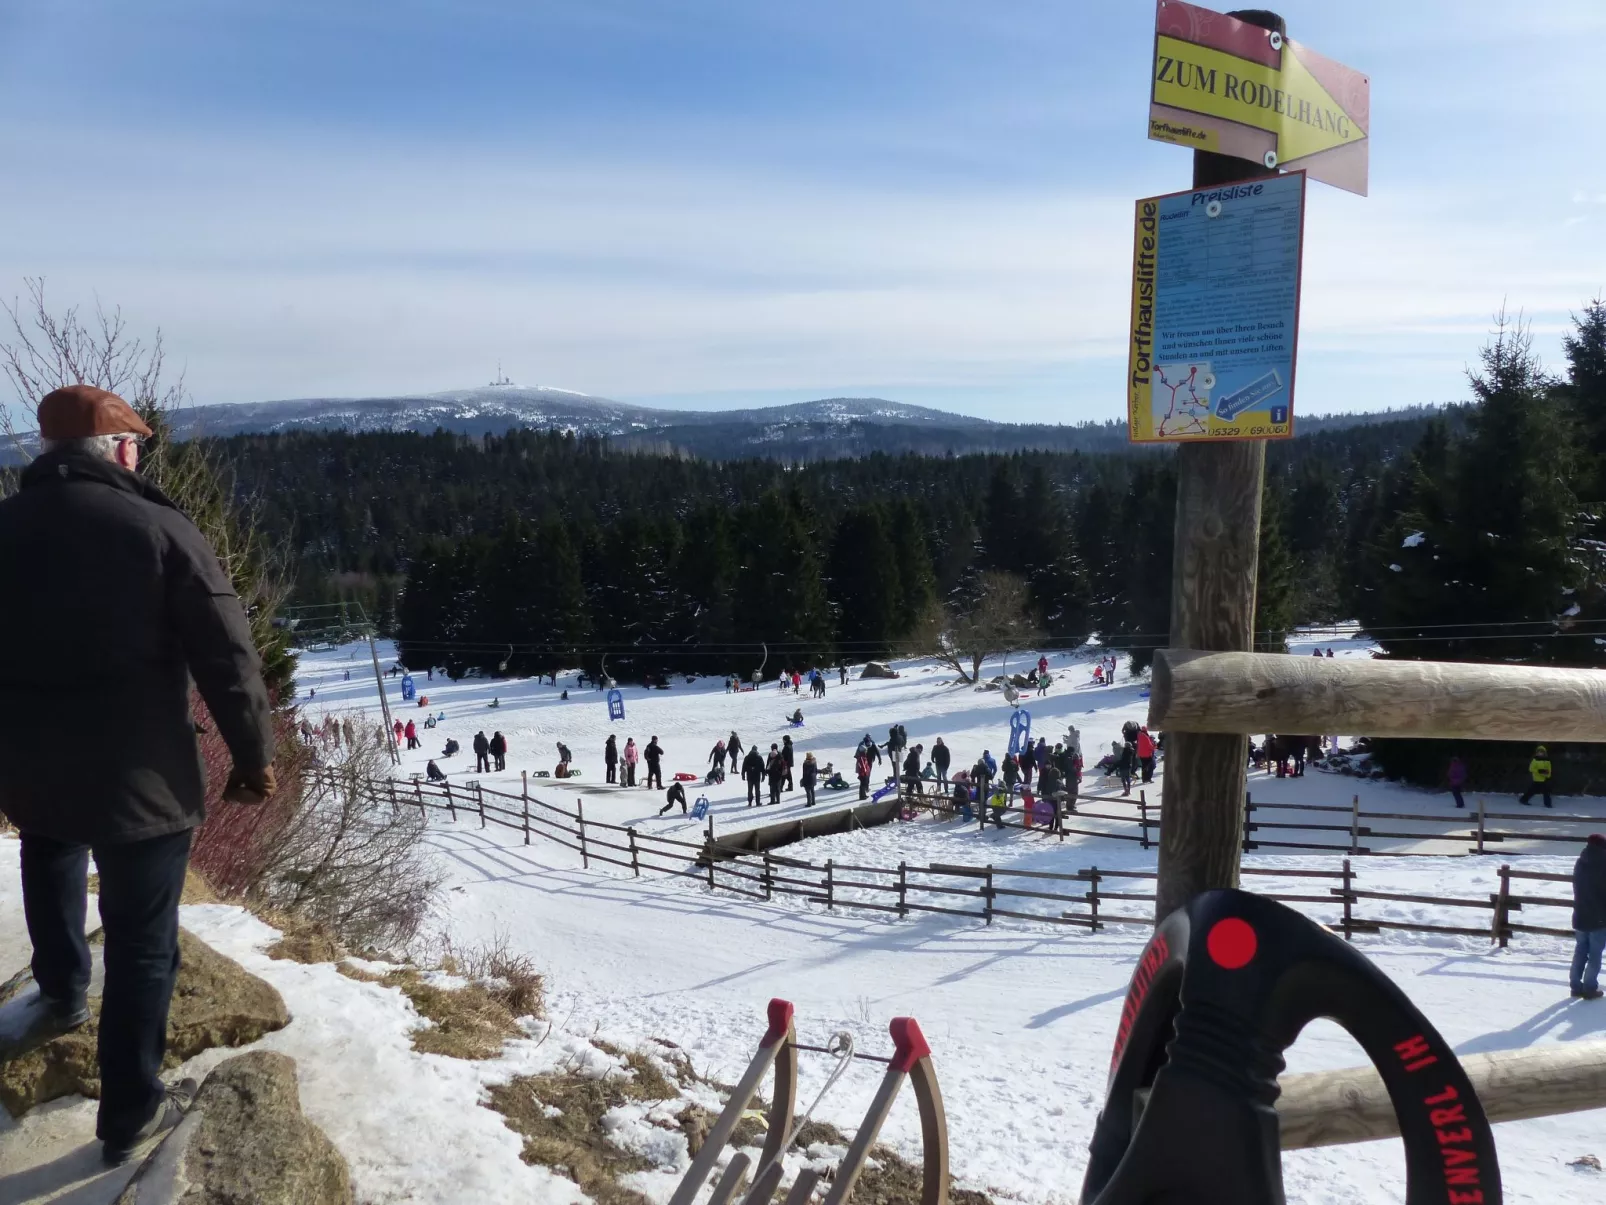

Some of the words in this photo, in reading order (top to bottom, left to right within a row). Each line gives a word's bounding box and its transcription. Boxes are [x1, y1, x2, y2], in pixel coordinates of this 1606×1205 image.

[1156, 56, 1217, 95] ZUM
[1224, 72, 1350, 139] RODELHANG
[1191, 184, 1264, 206] Preisliste
[1133, 202, 1157, 390] Torfhauslifte.de
[1162, 331, 1175, 339] Wir
[1177, 330, 1200, 338] freuen
[1159, 353, 1188, 361] Stunden
[1200, 349, 1214, 358] und
[1230, 346, 1259, 355] unseren
[1162, 341, 1176, 350] und
[1178, 339, 1213, 349] wünschen
